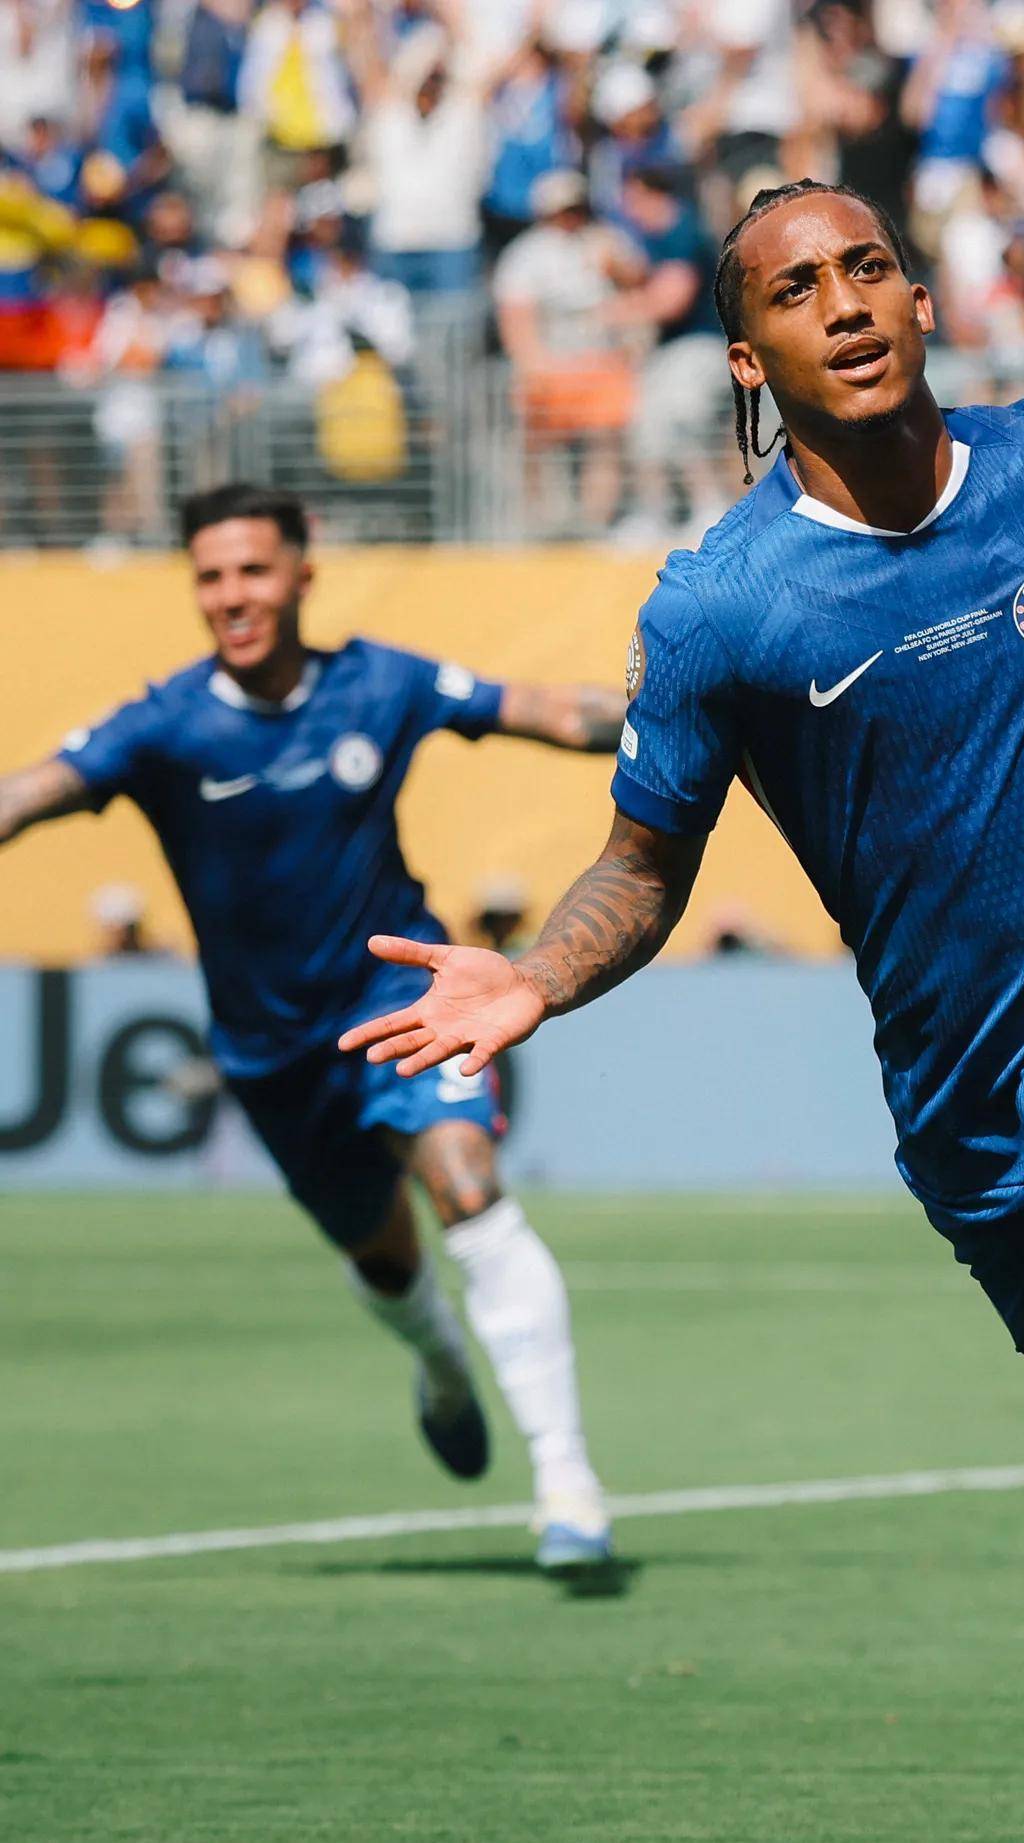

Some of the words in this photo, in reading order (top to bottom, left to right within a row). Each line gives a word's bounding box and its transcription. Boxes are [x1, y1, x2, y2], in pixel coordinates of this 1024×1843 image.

[894, 639, 923, 654] CHELSEA
[938, 628, 956, 638] PARIS
[956, 610, 1003, 631] SAINT-GERMAIN
[904, 633, 917, 642] FIFA
[917, 627, 934, 638] CLUB
[933, 619, 956, 632] WORLD
[957, 614, 971, 623] CUP
[970, 608, 988, 619] FINAL
[926, 638, 950, 651] SUNDAY
[961, 628, 976, 638] JULY
[918, 651, 934, 662] NEW
[951, 640, 966, 650] NEW
[965, 632, 988, 645] JERSEY
